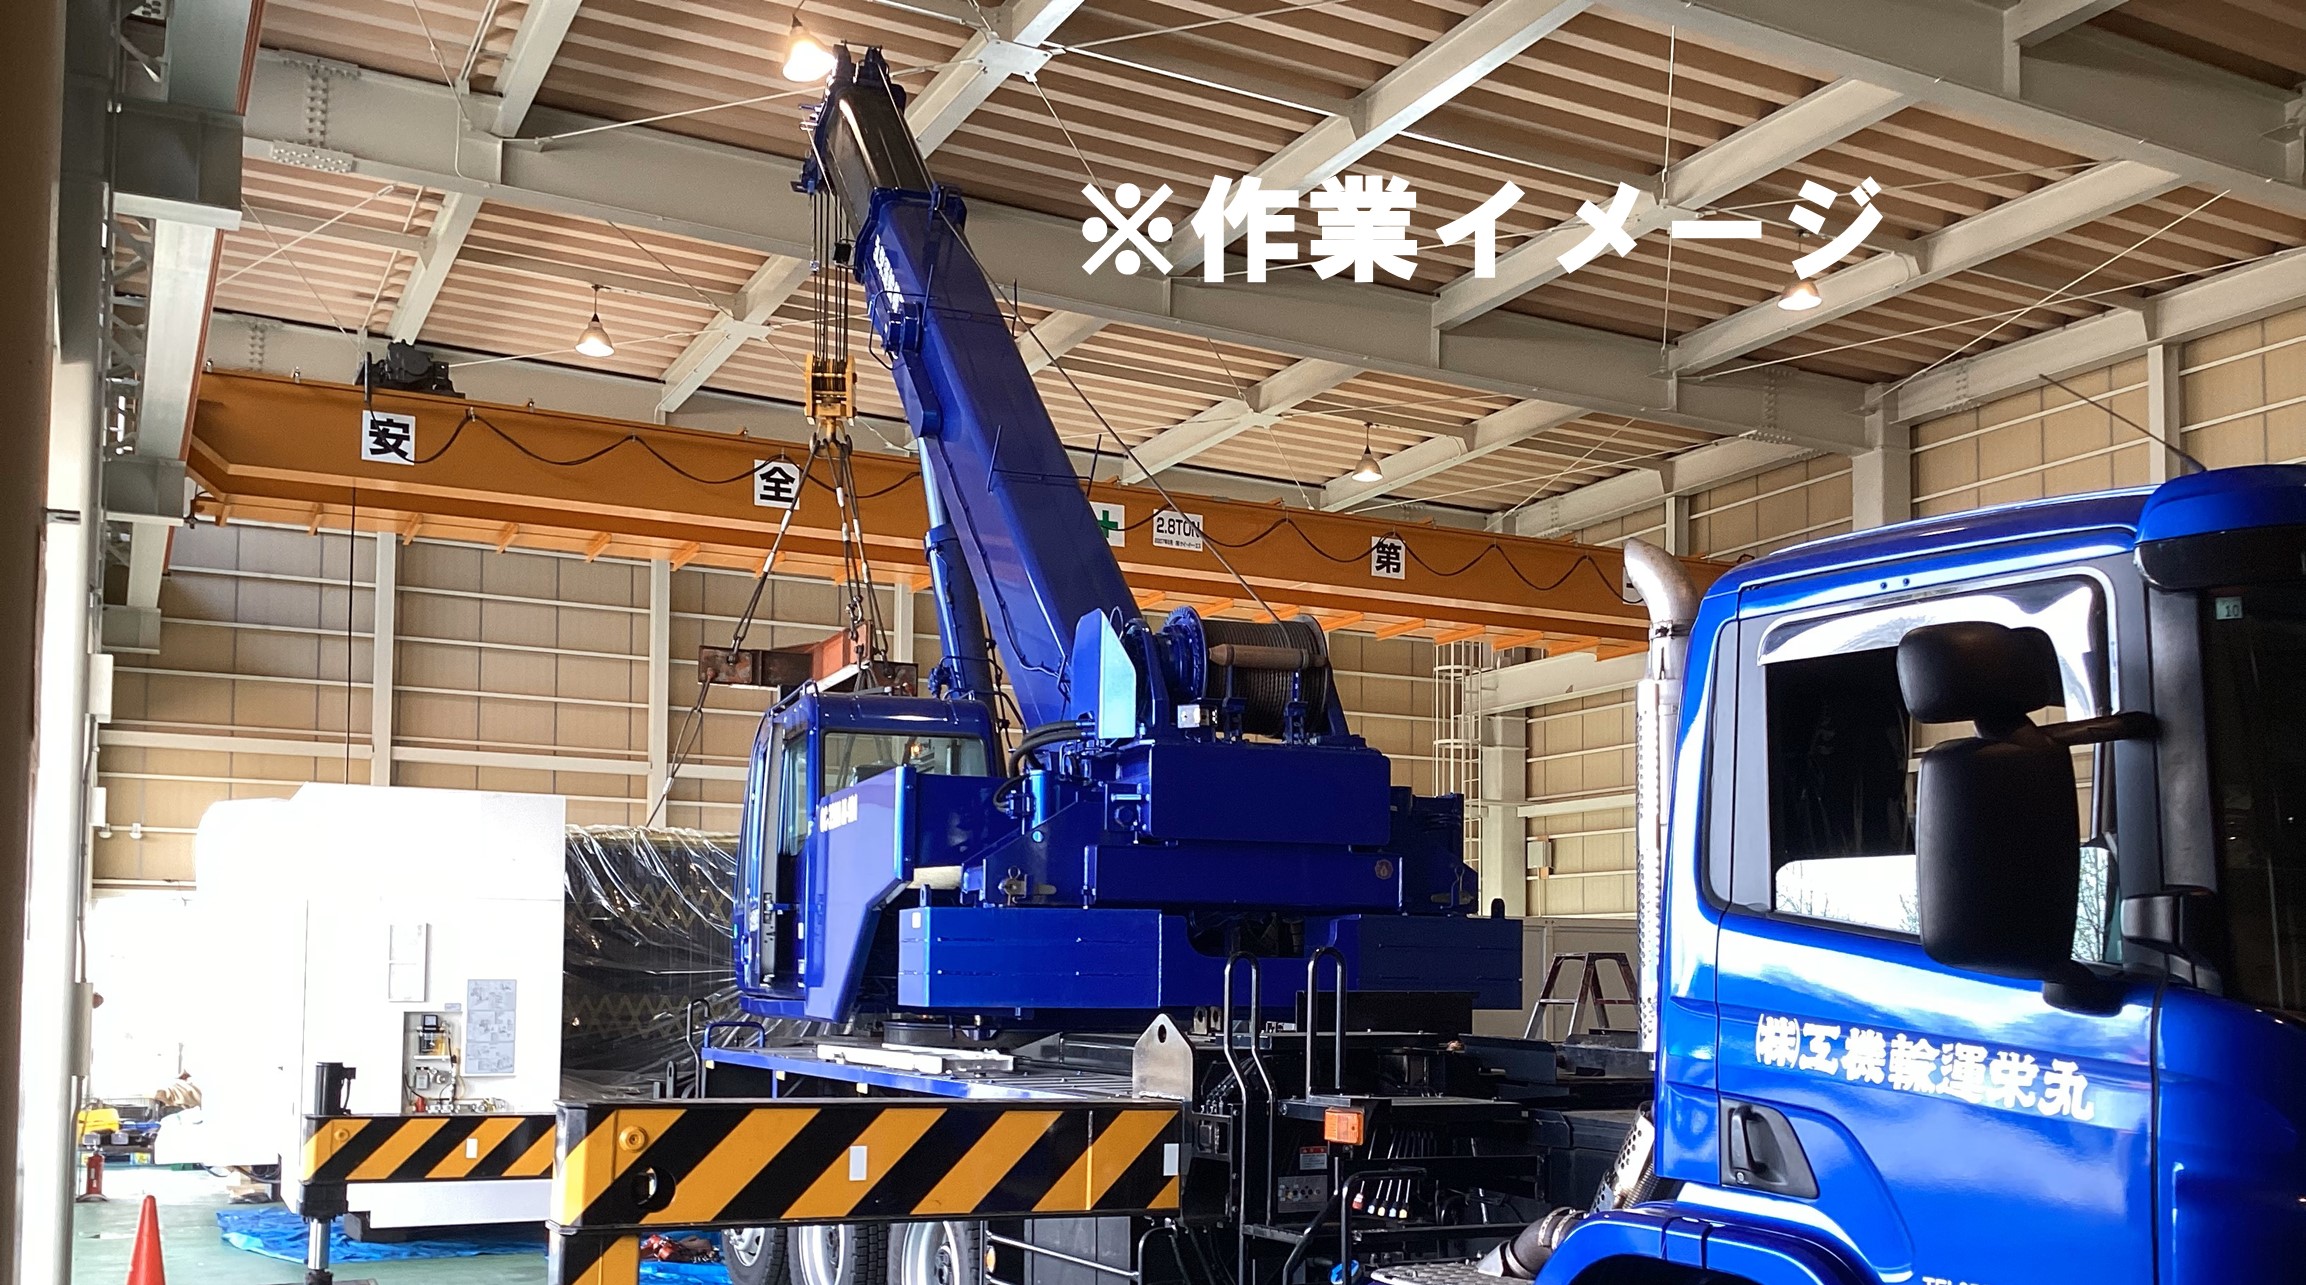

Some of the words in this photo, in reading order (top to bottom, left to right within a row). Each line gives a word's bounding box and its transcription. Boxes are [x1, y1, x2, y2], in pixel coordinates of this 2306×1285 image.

[368, 418, 411, 456] 安
[759, 466, 796, 503] 全
[1375, 542, 1402, 574] 第
[1156, 516, 1200, 538] 2.8TON
